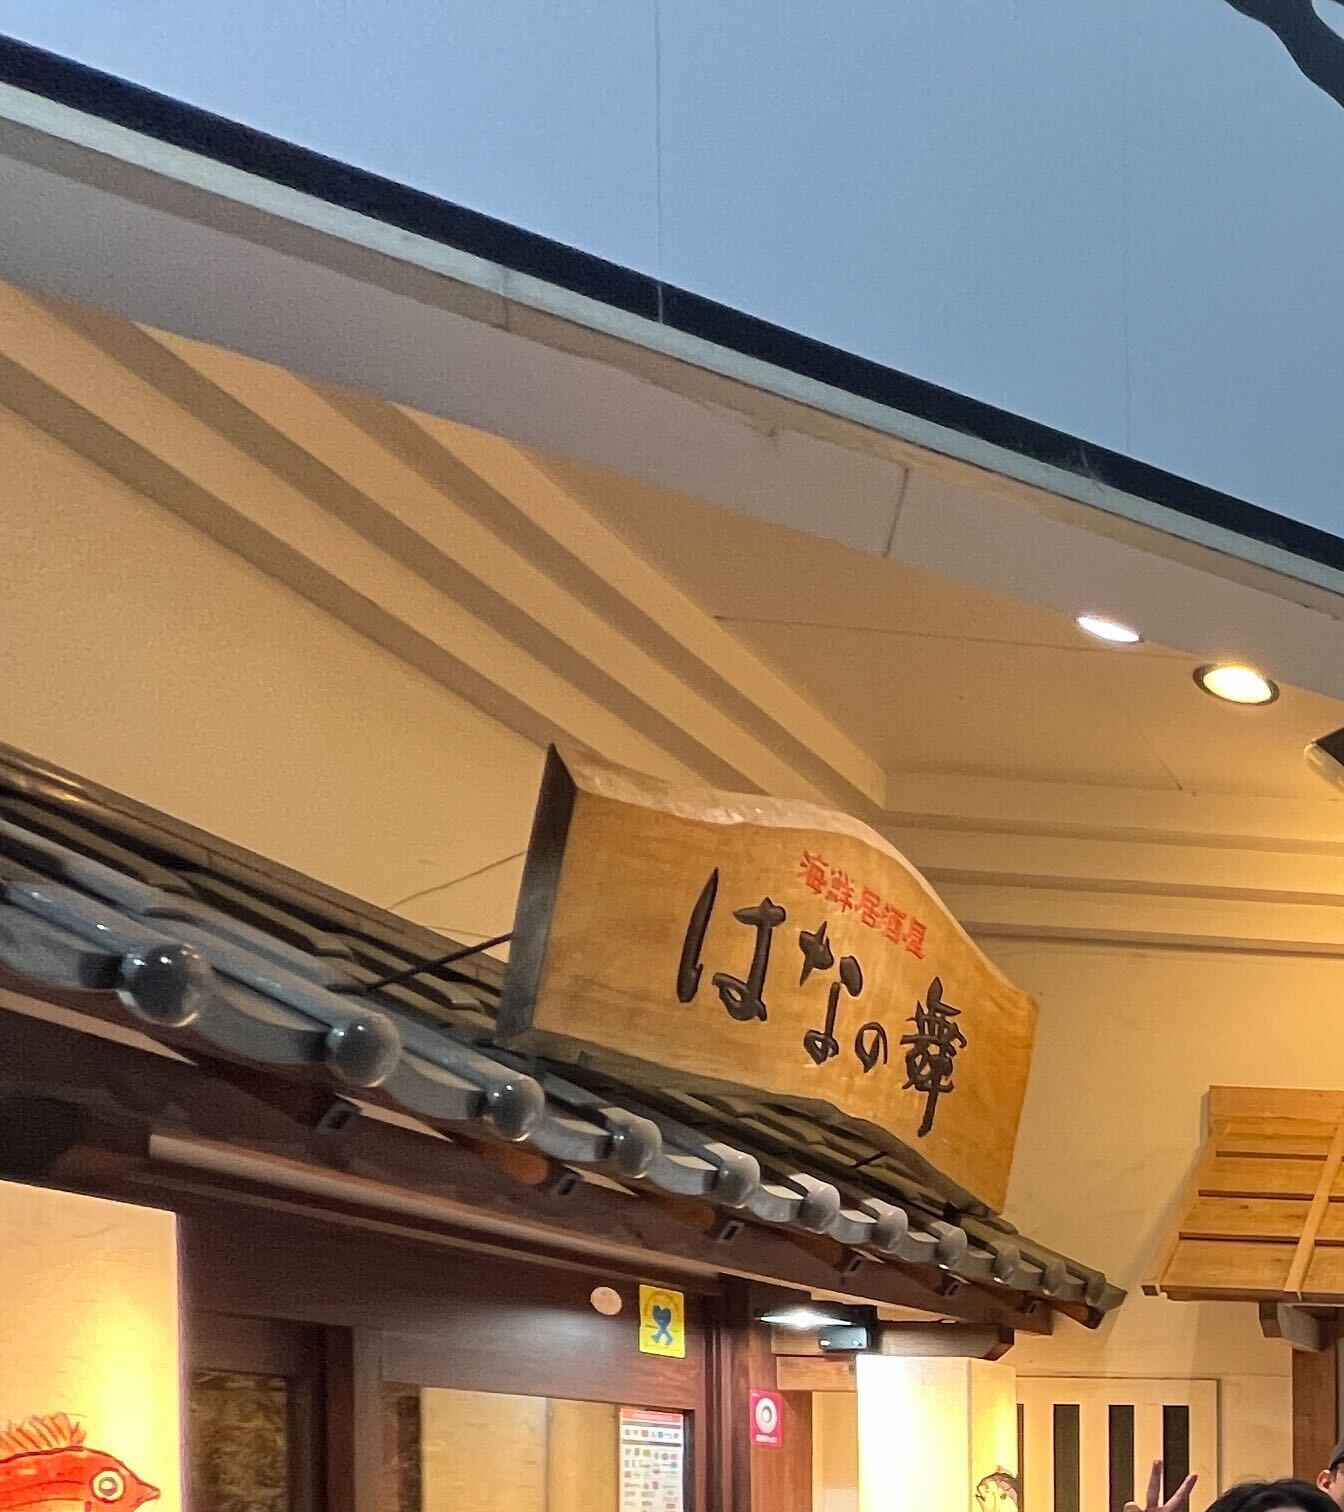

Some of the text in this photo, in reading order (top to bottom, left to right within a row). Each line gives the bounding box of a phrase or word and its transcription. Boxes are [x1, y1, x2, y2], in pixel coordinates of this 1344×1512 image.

[800, 849, 928, 960] 海鮮居酒屋
[676, 866, 968, 1138] はなの舞
